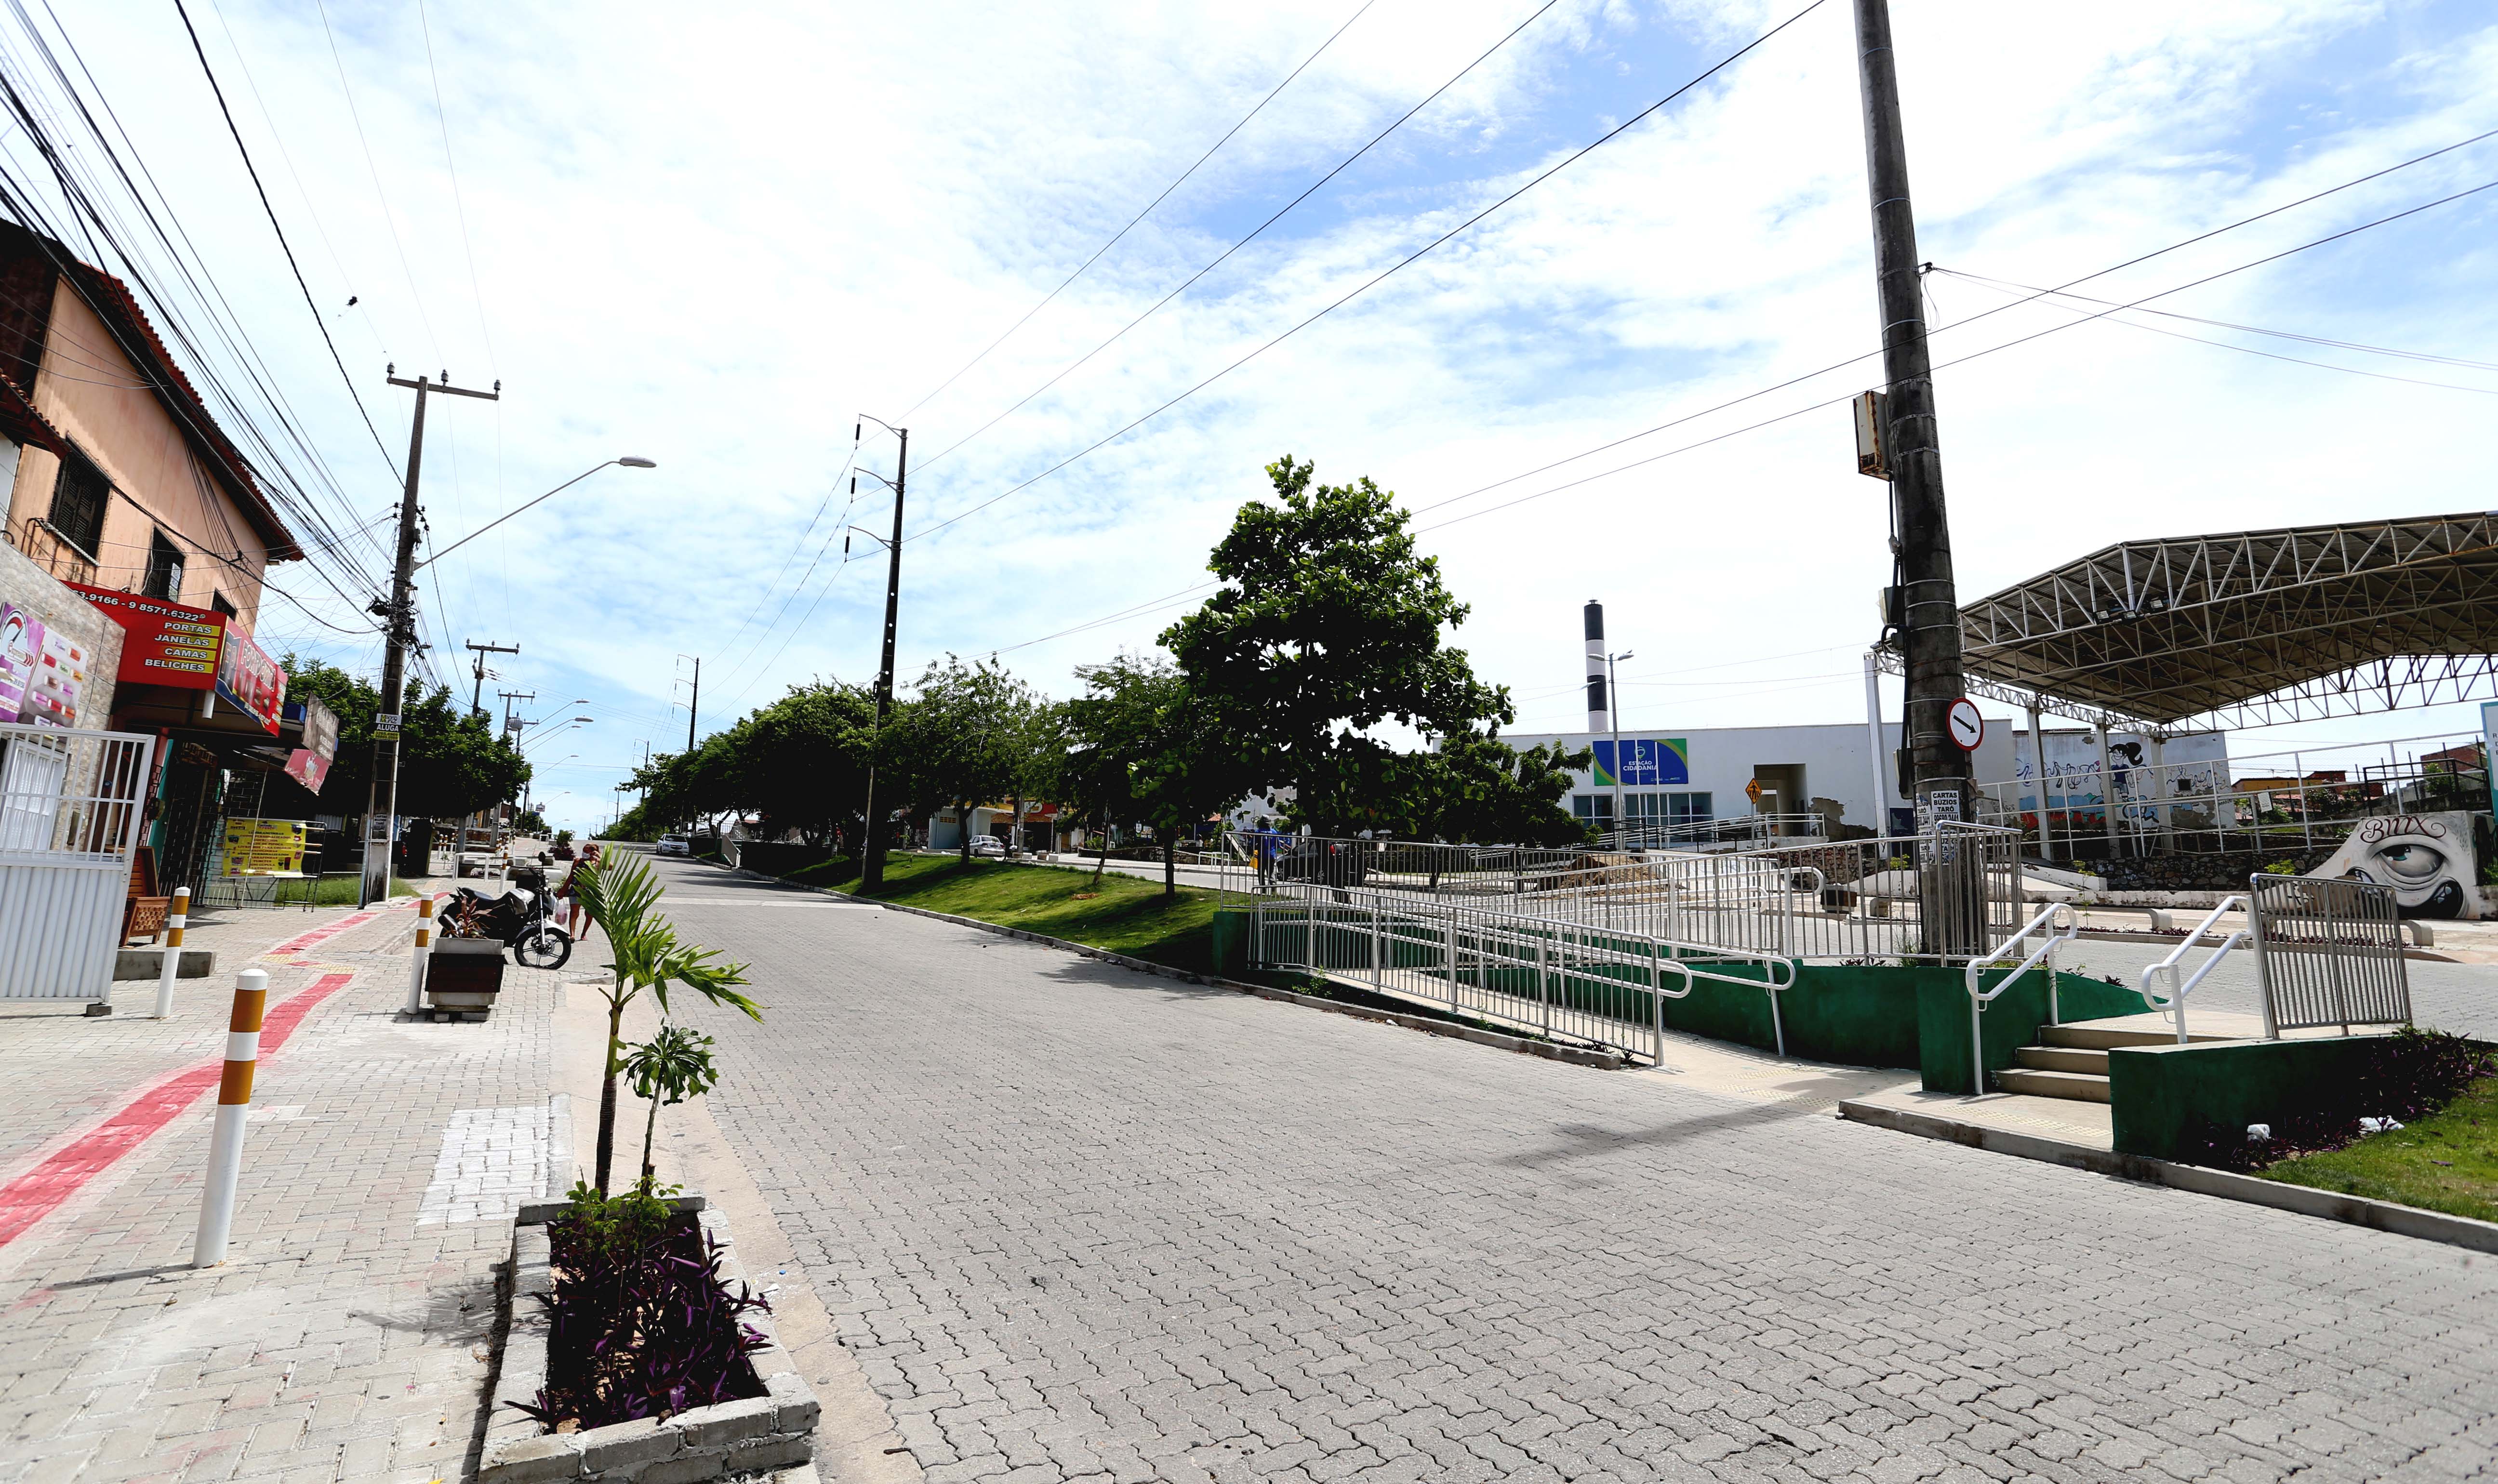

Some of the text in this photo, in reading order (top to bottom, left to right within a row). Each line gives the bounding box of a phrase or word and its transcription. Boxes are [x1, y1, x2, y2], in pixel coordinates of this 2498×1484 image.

[139, 603, 199, 622] 8571.6322
[164, 622, 212, 634] PORTAS
[154, 634, 209, 647] JANELAS
[164, 648, 207, 659] CAMAS
[145, 659, 205, 672] BELICHES
[376, 724, 399, 732] ALUGA
[2360, 816, 2446, 844] BMX
